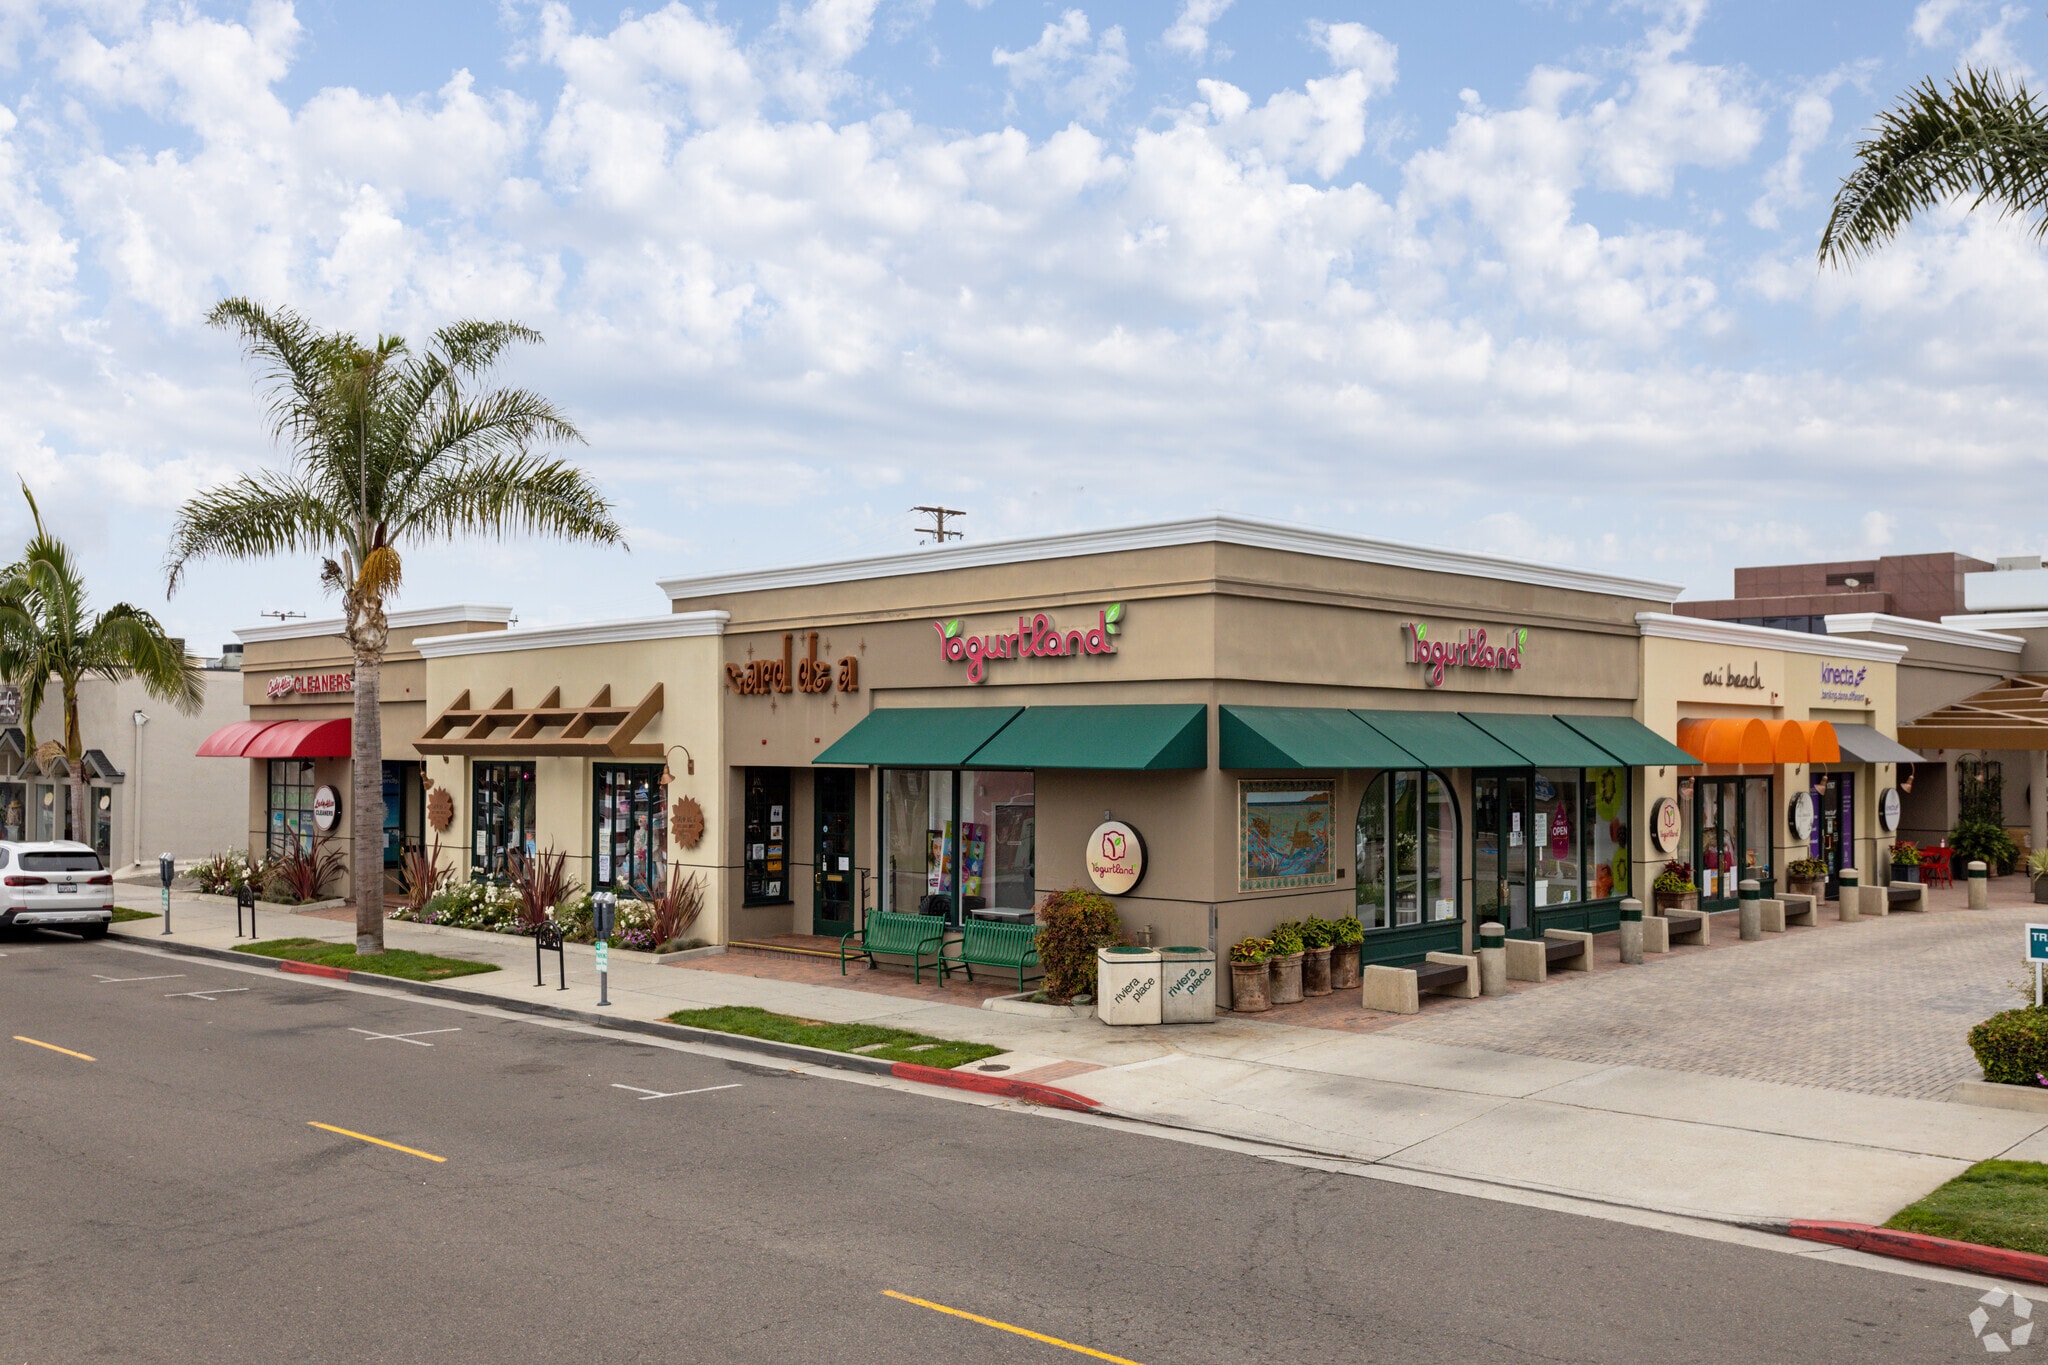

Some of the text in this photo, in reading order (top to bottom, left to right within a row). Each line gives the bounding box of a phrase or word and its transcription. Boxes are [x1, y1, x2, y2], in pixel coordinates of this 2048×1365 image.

[933, 606, 1120, 683] Yogurtland
[1408, 622, 1525, 687] Yogurtland
[293, 673, 352, 693] CLEANERS
[1703, 661, 1765, 690] oui beach
[1821, 660, 1854, 686] kinecta
[315, 809, 334, 817] CLEANERS
[1552, 826, 1568, 836] OPEN
[1091, 862, 1136, 878] Yogurtland
[1114, 977, 1141, 1004] riviera
[1132, 977, 1155, 1003] place
[1167, 968, 1197, 997] riviera
[1186, 967, 1212, 995] place
